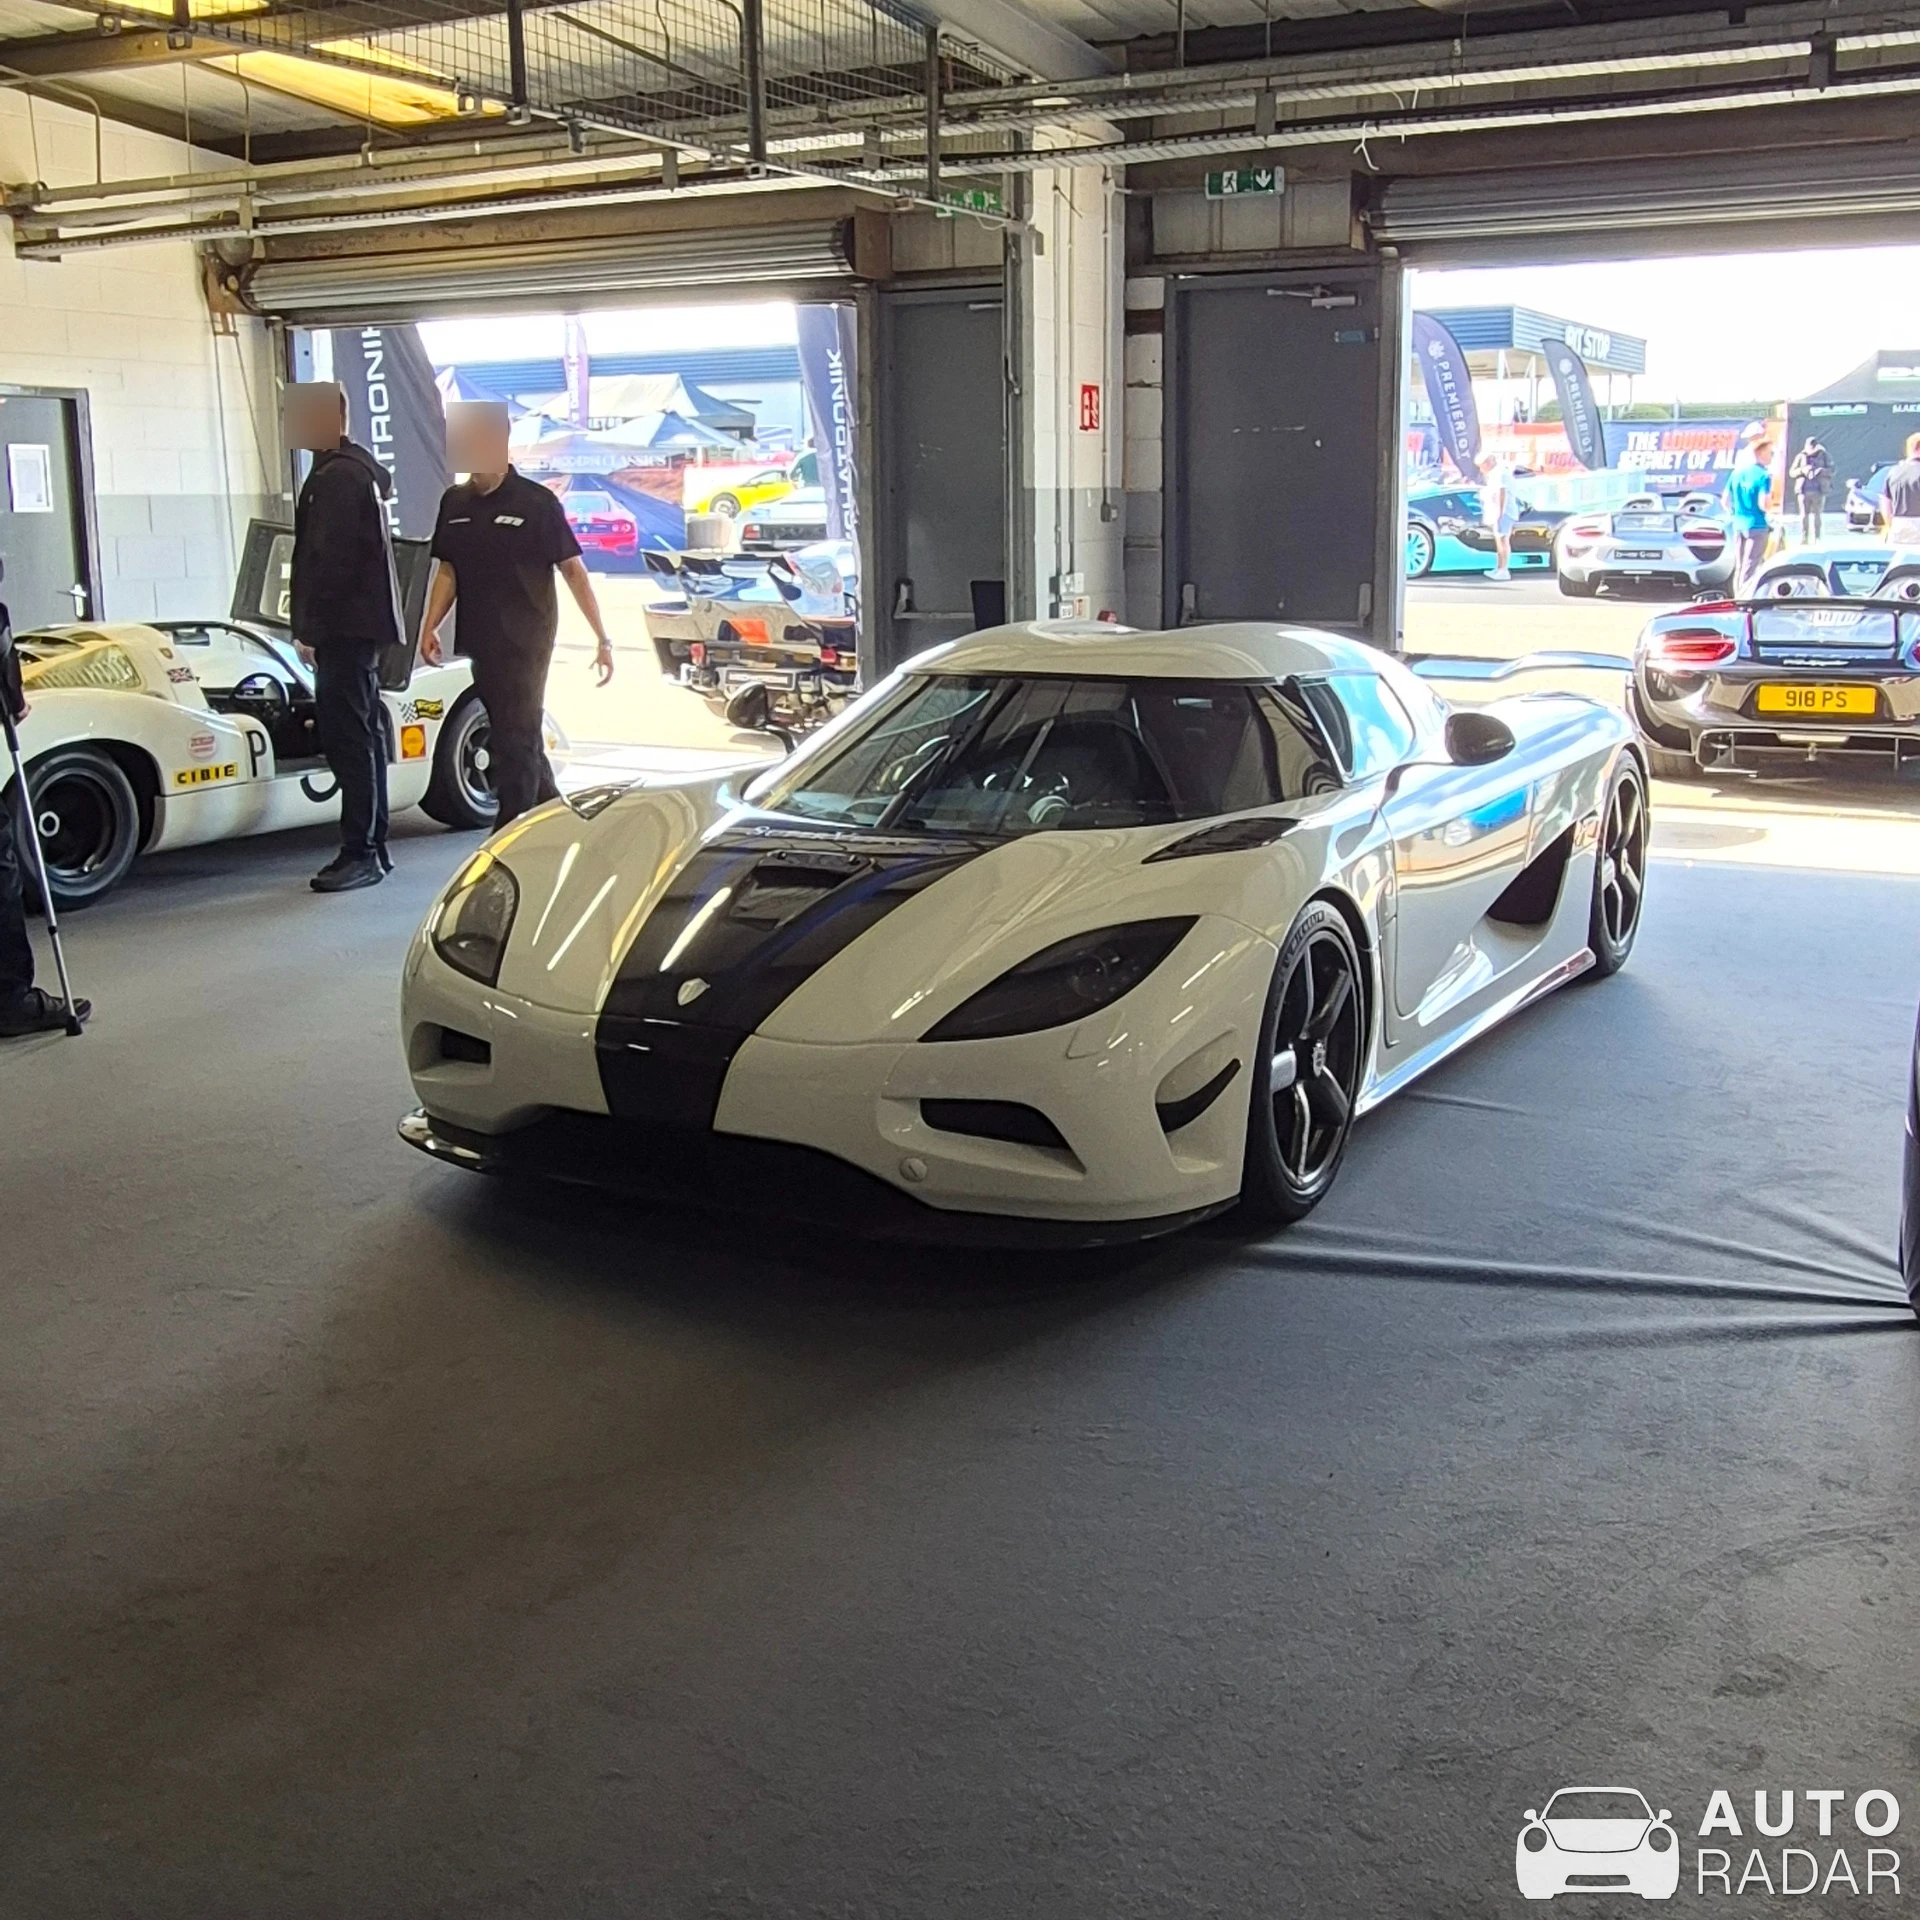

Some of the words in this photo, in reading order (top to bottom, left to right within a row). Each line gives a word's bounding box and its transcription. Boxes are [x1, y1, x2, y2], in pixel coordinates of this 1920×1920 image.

[1583, 329, 1611, 360] STOP
[1628, 431, 1660, 450] THE
[1687, 451, 1713, 469] OF
[1785, 690, 1816, 707] 918
[1822, 691, 1848, 708] PS
[177, 764, 235, 785] CIBIE
